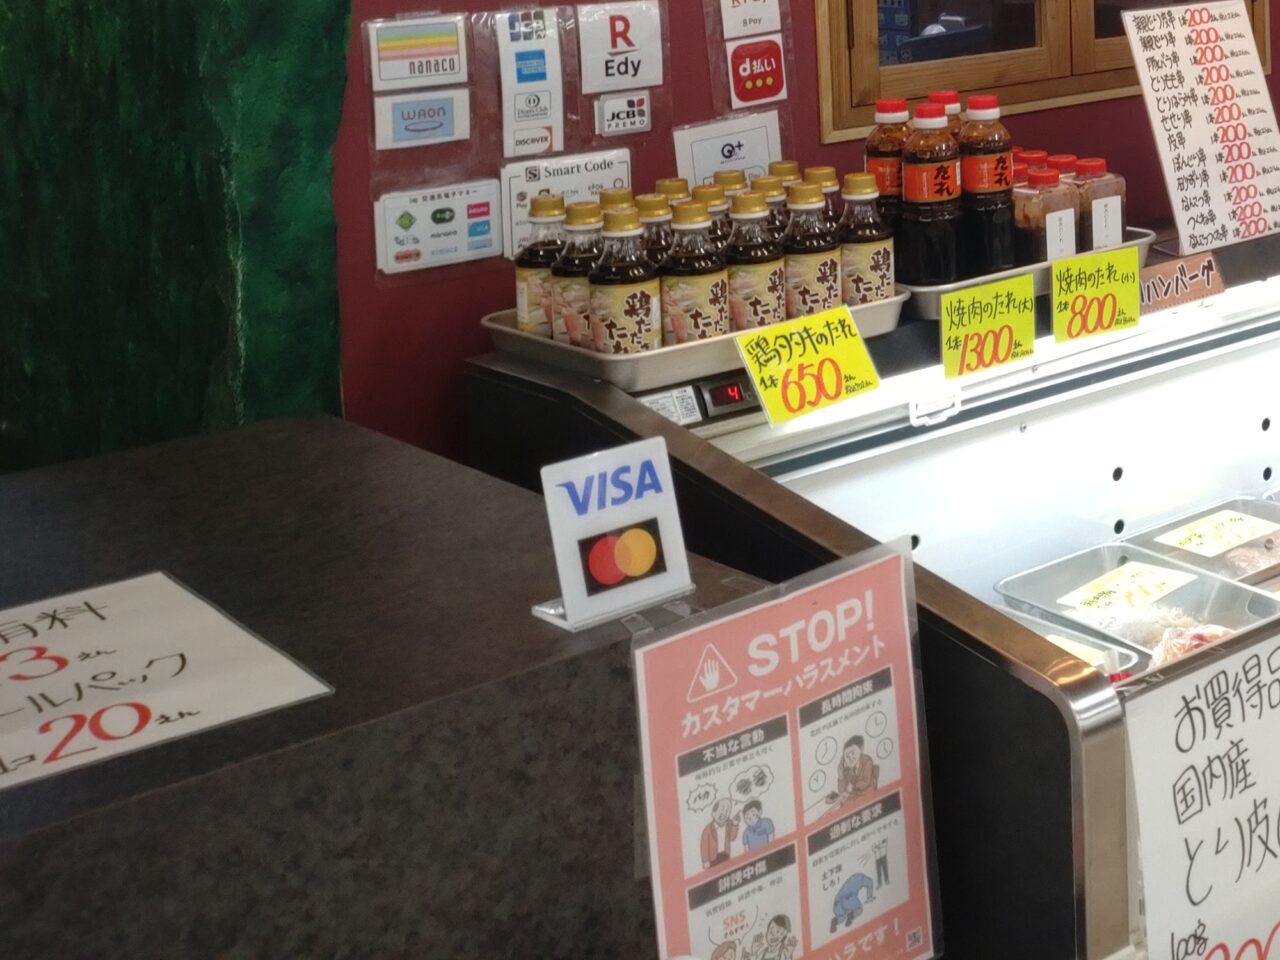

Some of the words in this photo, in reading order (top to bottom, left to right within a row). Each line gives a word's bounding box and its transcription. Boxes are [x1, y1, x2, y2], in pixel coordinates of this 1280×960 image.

[1184, 7, 1211, 27] 200
[1190, 27, 1219, 45] 200
[1196, 45, 1224, 65] 200
[409, 57, 456, 75] nanaco
[604, 56, 642, 77] Edy
[738, 57, 777, 77] d払い
[1201, 64, 1230, 85] 200
[1208, 84, 1235, 106] 200
[606, 108, 636, 122] JCB
[1214, 103, 1241, 124] 200
[607, 119, 646, 130] PREMO
[1217, 123, 1247, 144] 200
[1222, 142, 1252, 164] 200
[544, 162, 582, 179] Smart
[584, 159, 614, 173] Code
[1227, 162, 1256, 184] 200
[1232, 184, 1258, 205] 200
[1236, 201, 1262, 221] 200
[1240, 217, 1268, 239] 200
[1139, 257, 1215, 304] ハンバーグ
[1067, 292, 1118, 340] 800
[958, 324, 1014, 376] 1300
[727, 385, 739, 400] 4
[781, 357, 843, 415] 650
[556, 459, 663, 516] VISA
[748, 589, 876, 677] STOP!
[681, 634, 886, 738] カスタマーハラスメント
[38, 701, 153, 764] 20
[1172, 738, 1257, 826] 国内産
